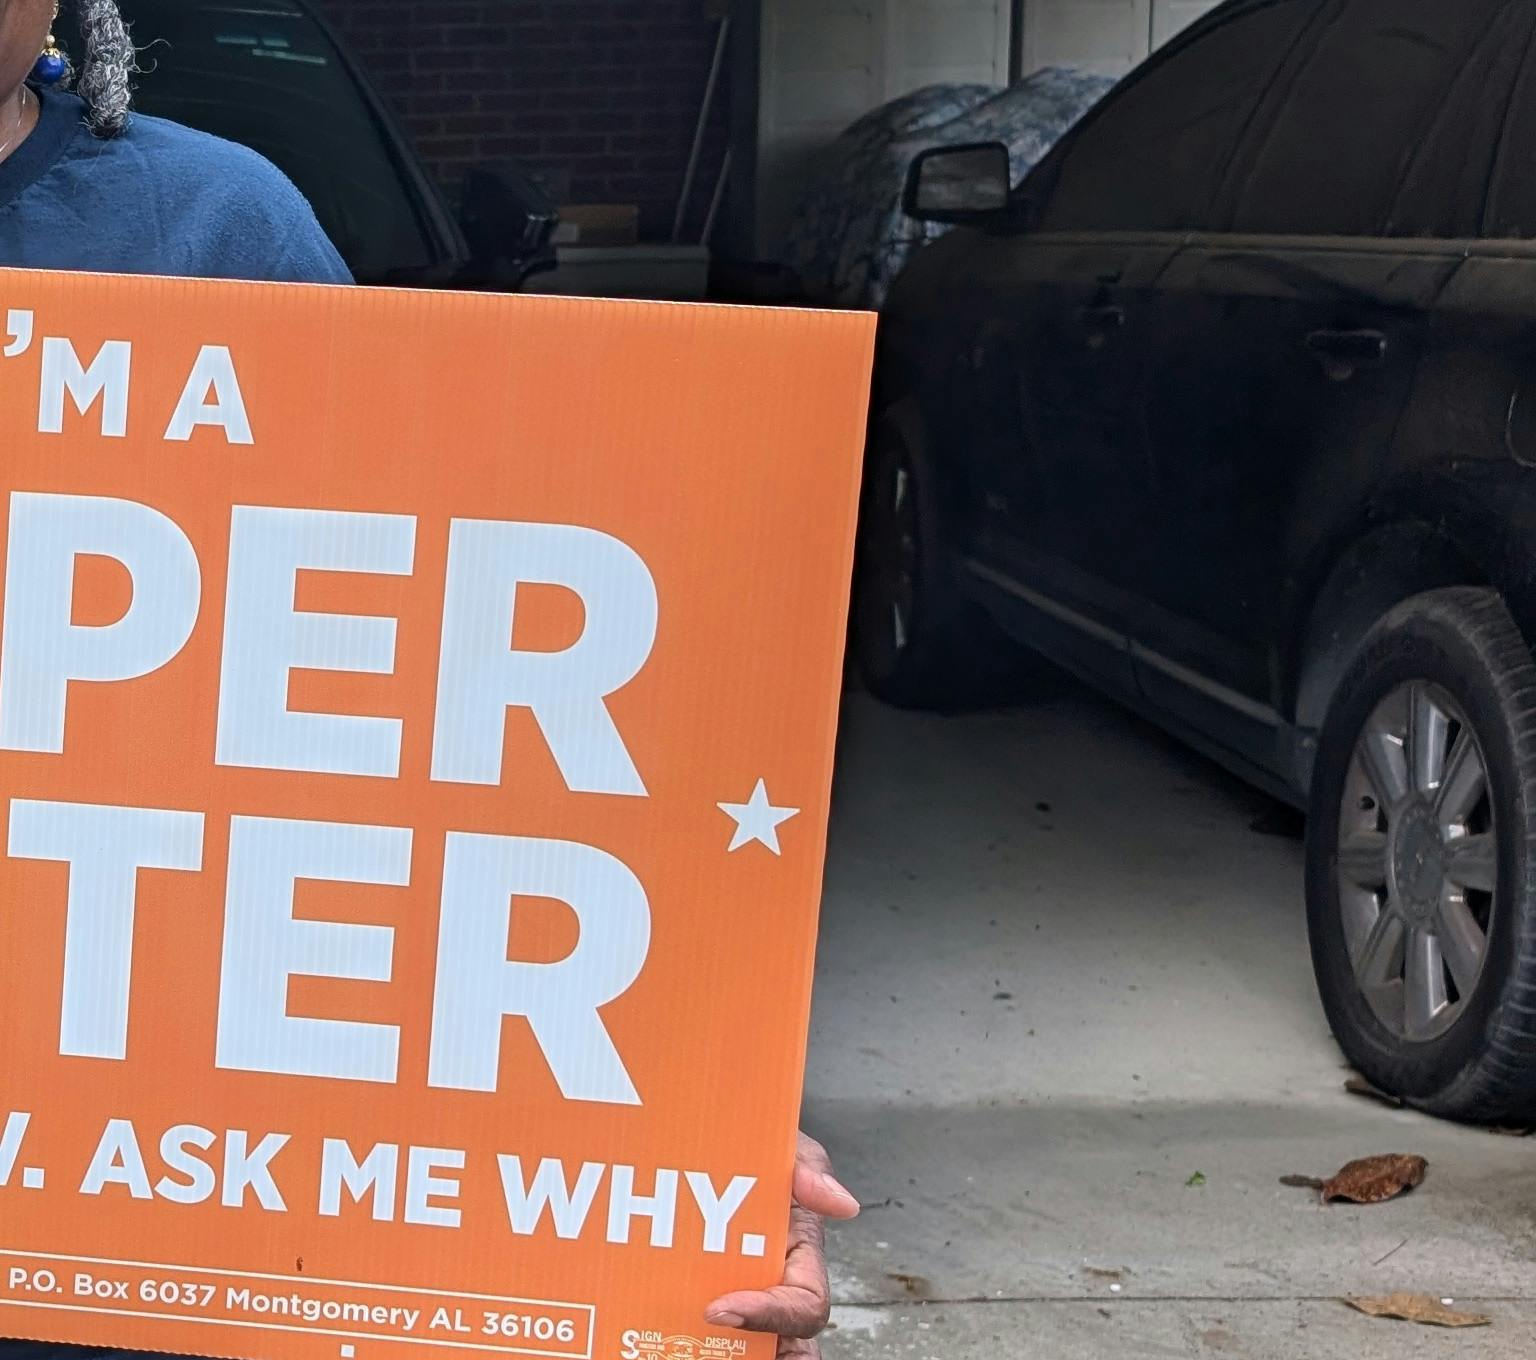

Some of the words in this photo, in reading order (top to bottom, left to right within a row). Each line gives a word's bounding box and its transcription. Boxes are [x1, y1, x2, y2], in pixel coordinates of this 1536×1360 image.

[163, 344, 254, 445] A
[78, 1118, 291, 1212] ASK
[318, 1137, 466, 1228] ME
[496, 1153, 766, 1257] WHY.
[9, 1267, 63, 1293] P.O.
[74, 1273, 129, 1299] Box
[139, 1279, 216, 1307] 6037
[226, 1287, 420, 1331] Montgomery
[429, 1307, 471, 1332] AL
[481, 1311, 575, 1342] 36106
